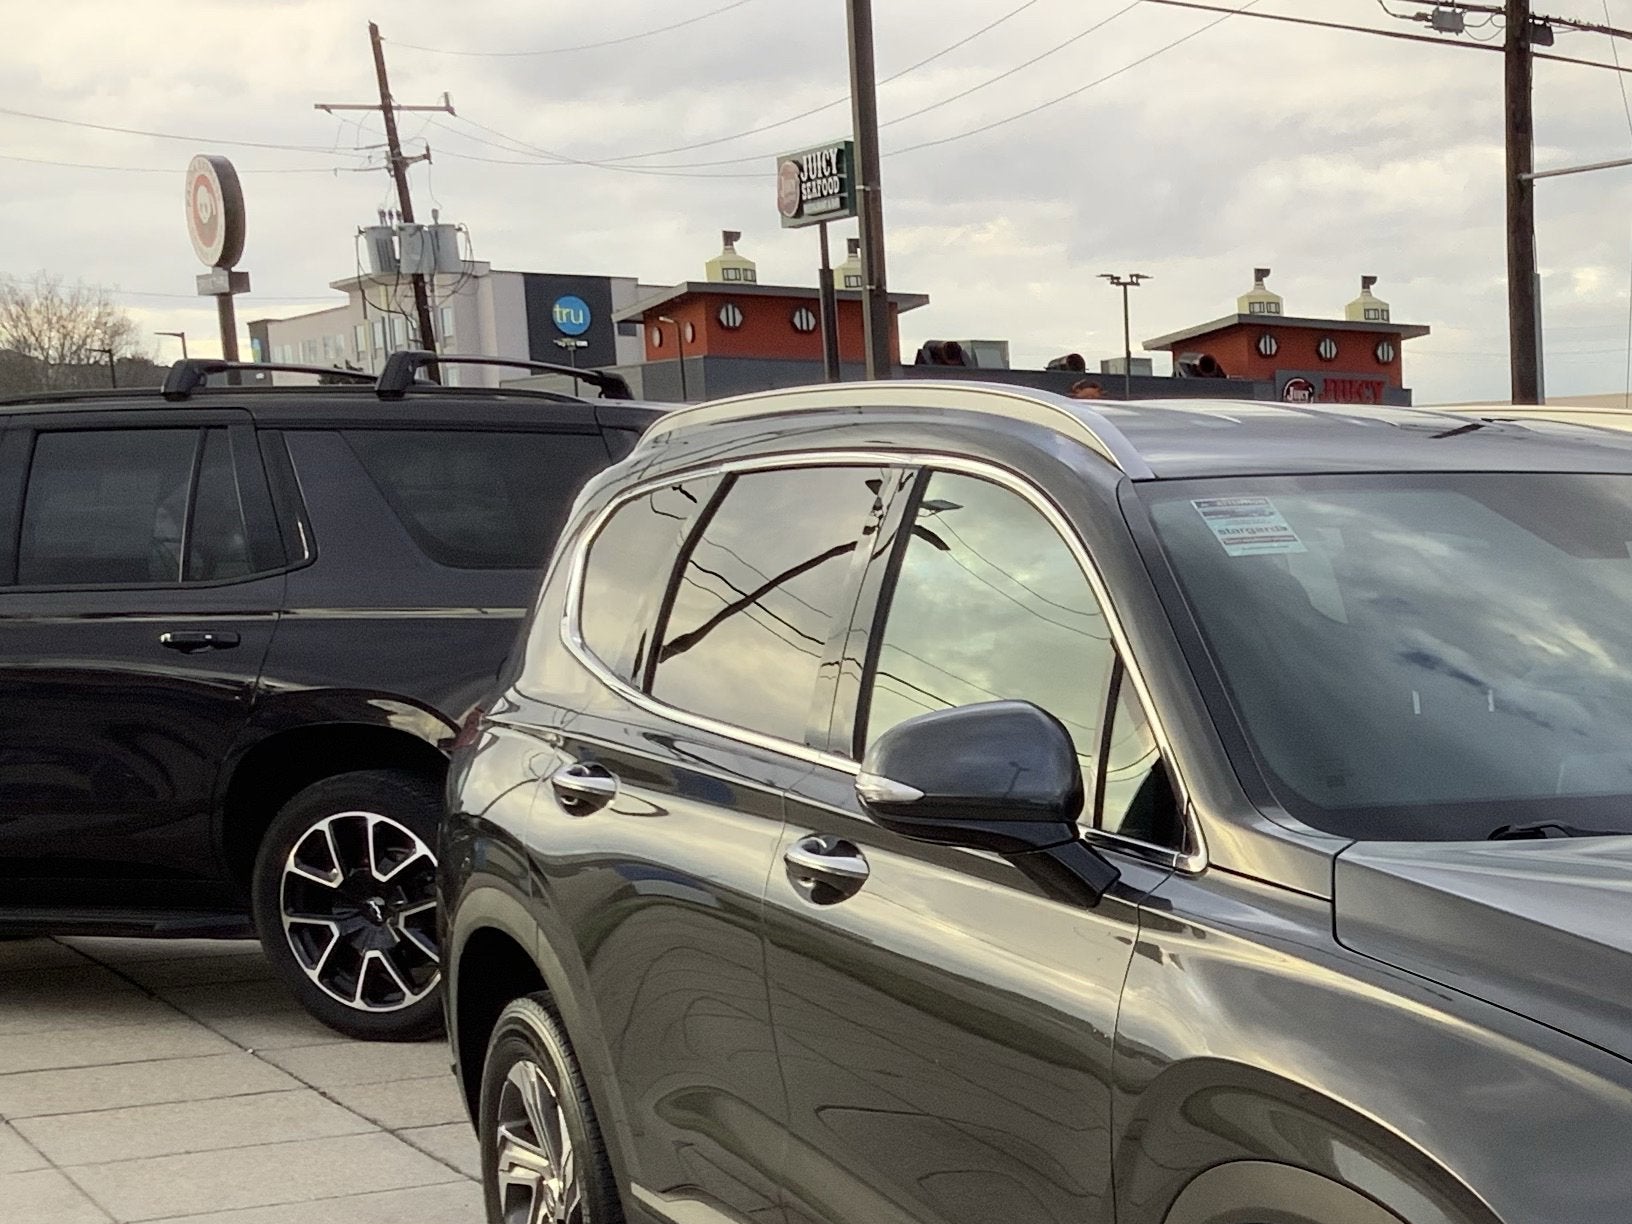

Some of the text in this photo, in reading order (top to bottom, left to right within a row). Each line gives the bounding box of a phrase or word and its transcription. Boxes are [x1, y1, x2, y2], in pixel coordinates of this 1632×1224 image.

[800, 147, 838, 182] JUICY
[801, 175, 840, 200] SEAFOOD
[553, 304, 584, 324] tru
[1318, 378, 1384, 403] JUICY
